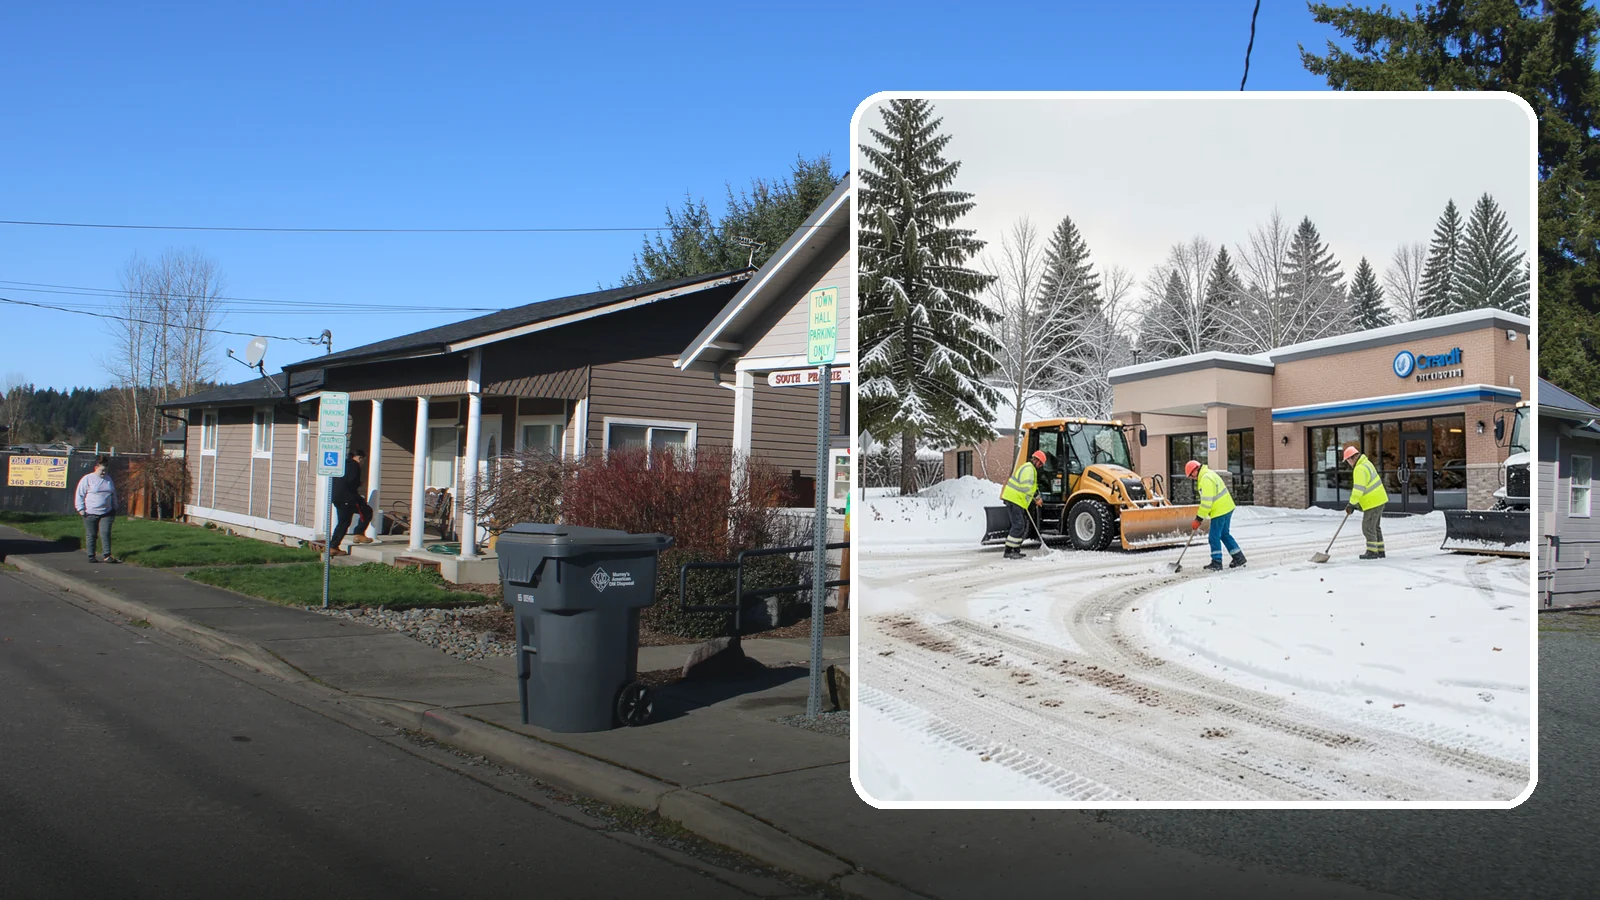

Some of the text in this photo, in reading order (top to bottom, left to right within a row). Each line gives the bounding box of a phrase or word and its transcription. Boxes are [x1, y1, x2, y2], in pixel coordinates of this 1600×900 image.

[815, 294, 833, 307] TOWN
[815, 311, 831, 324] HALL
[810, 326, 836, 341] PARKING
[813, 344, 831, 357] ONLY
[775, 373, 801, 384] SOUTH
[808, 371, 842, 383] PRIE
[10, 479, 66, 487] 360-897-8625
